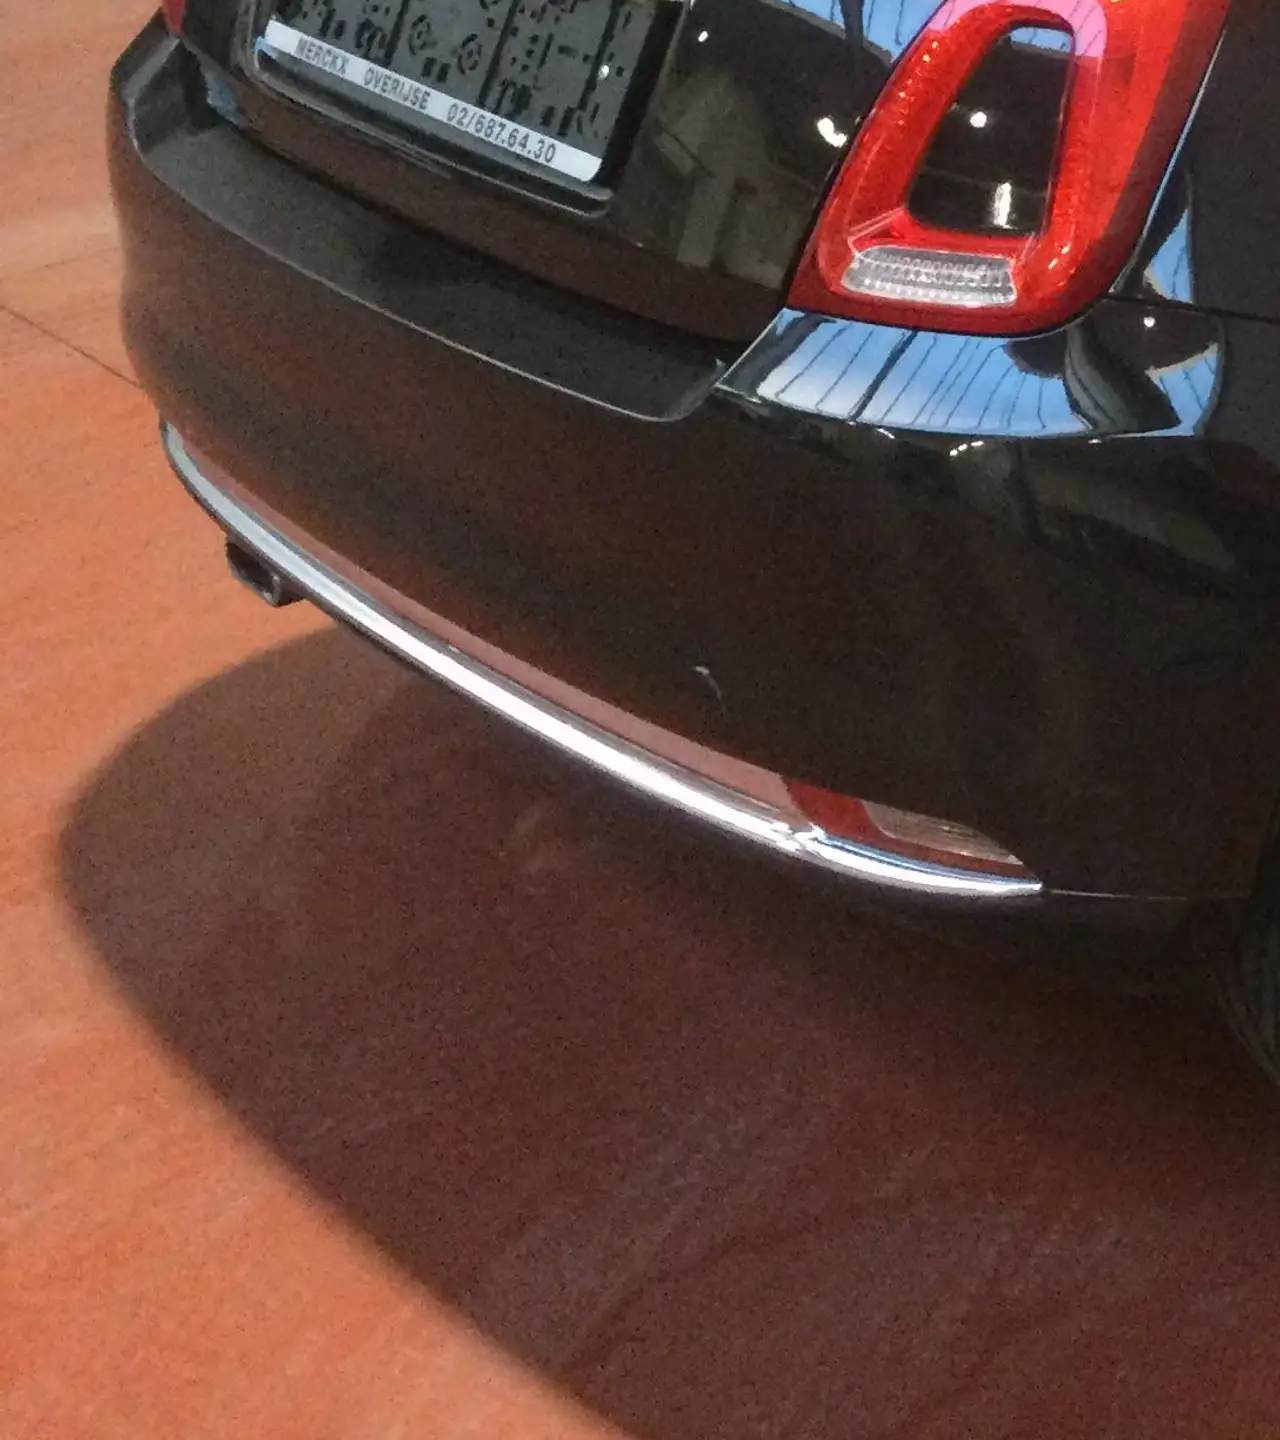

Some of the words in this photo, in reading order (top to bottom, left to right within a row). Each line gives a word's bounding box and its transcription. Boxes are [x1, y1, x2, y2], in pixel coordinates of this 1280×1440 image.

[295, 38, 349, 75] MERCKX
[363, 67, 431, 109] OVERIJSE
[447, 103, 556, 163] 02/687.64.30
